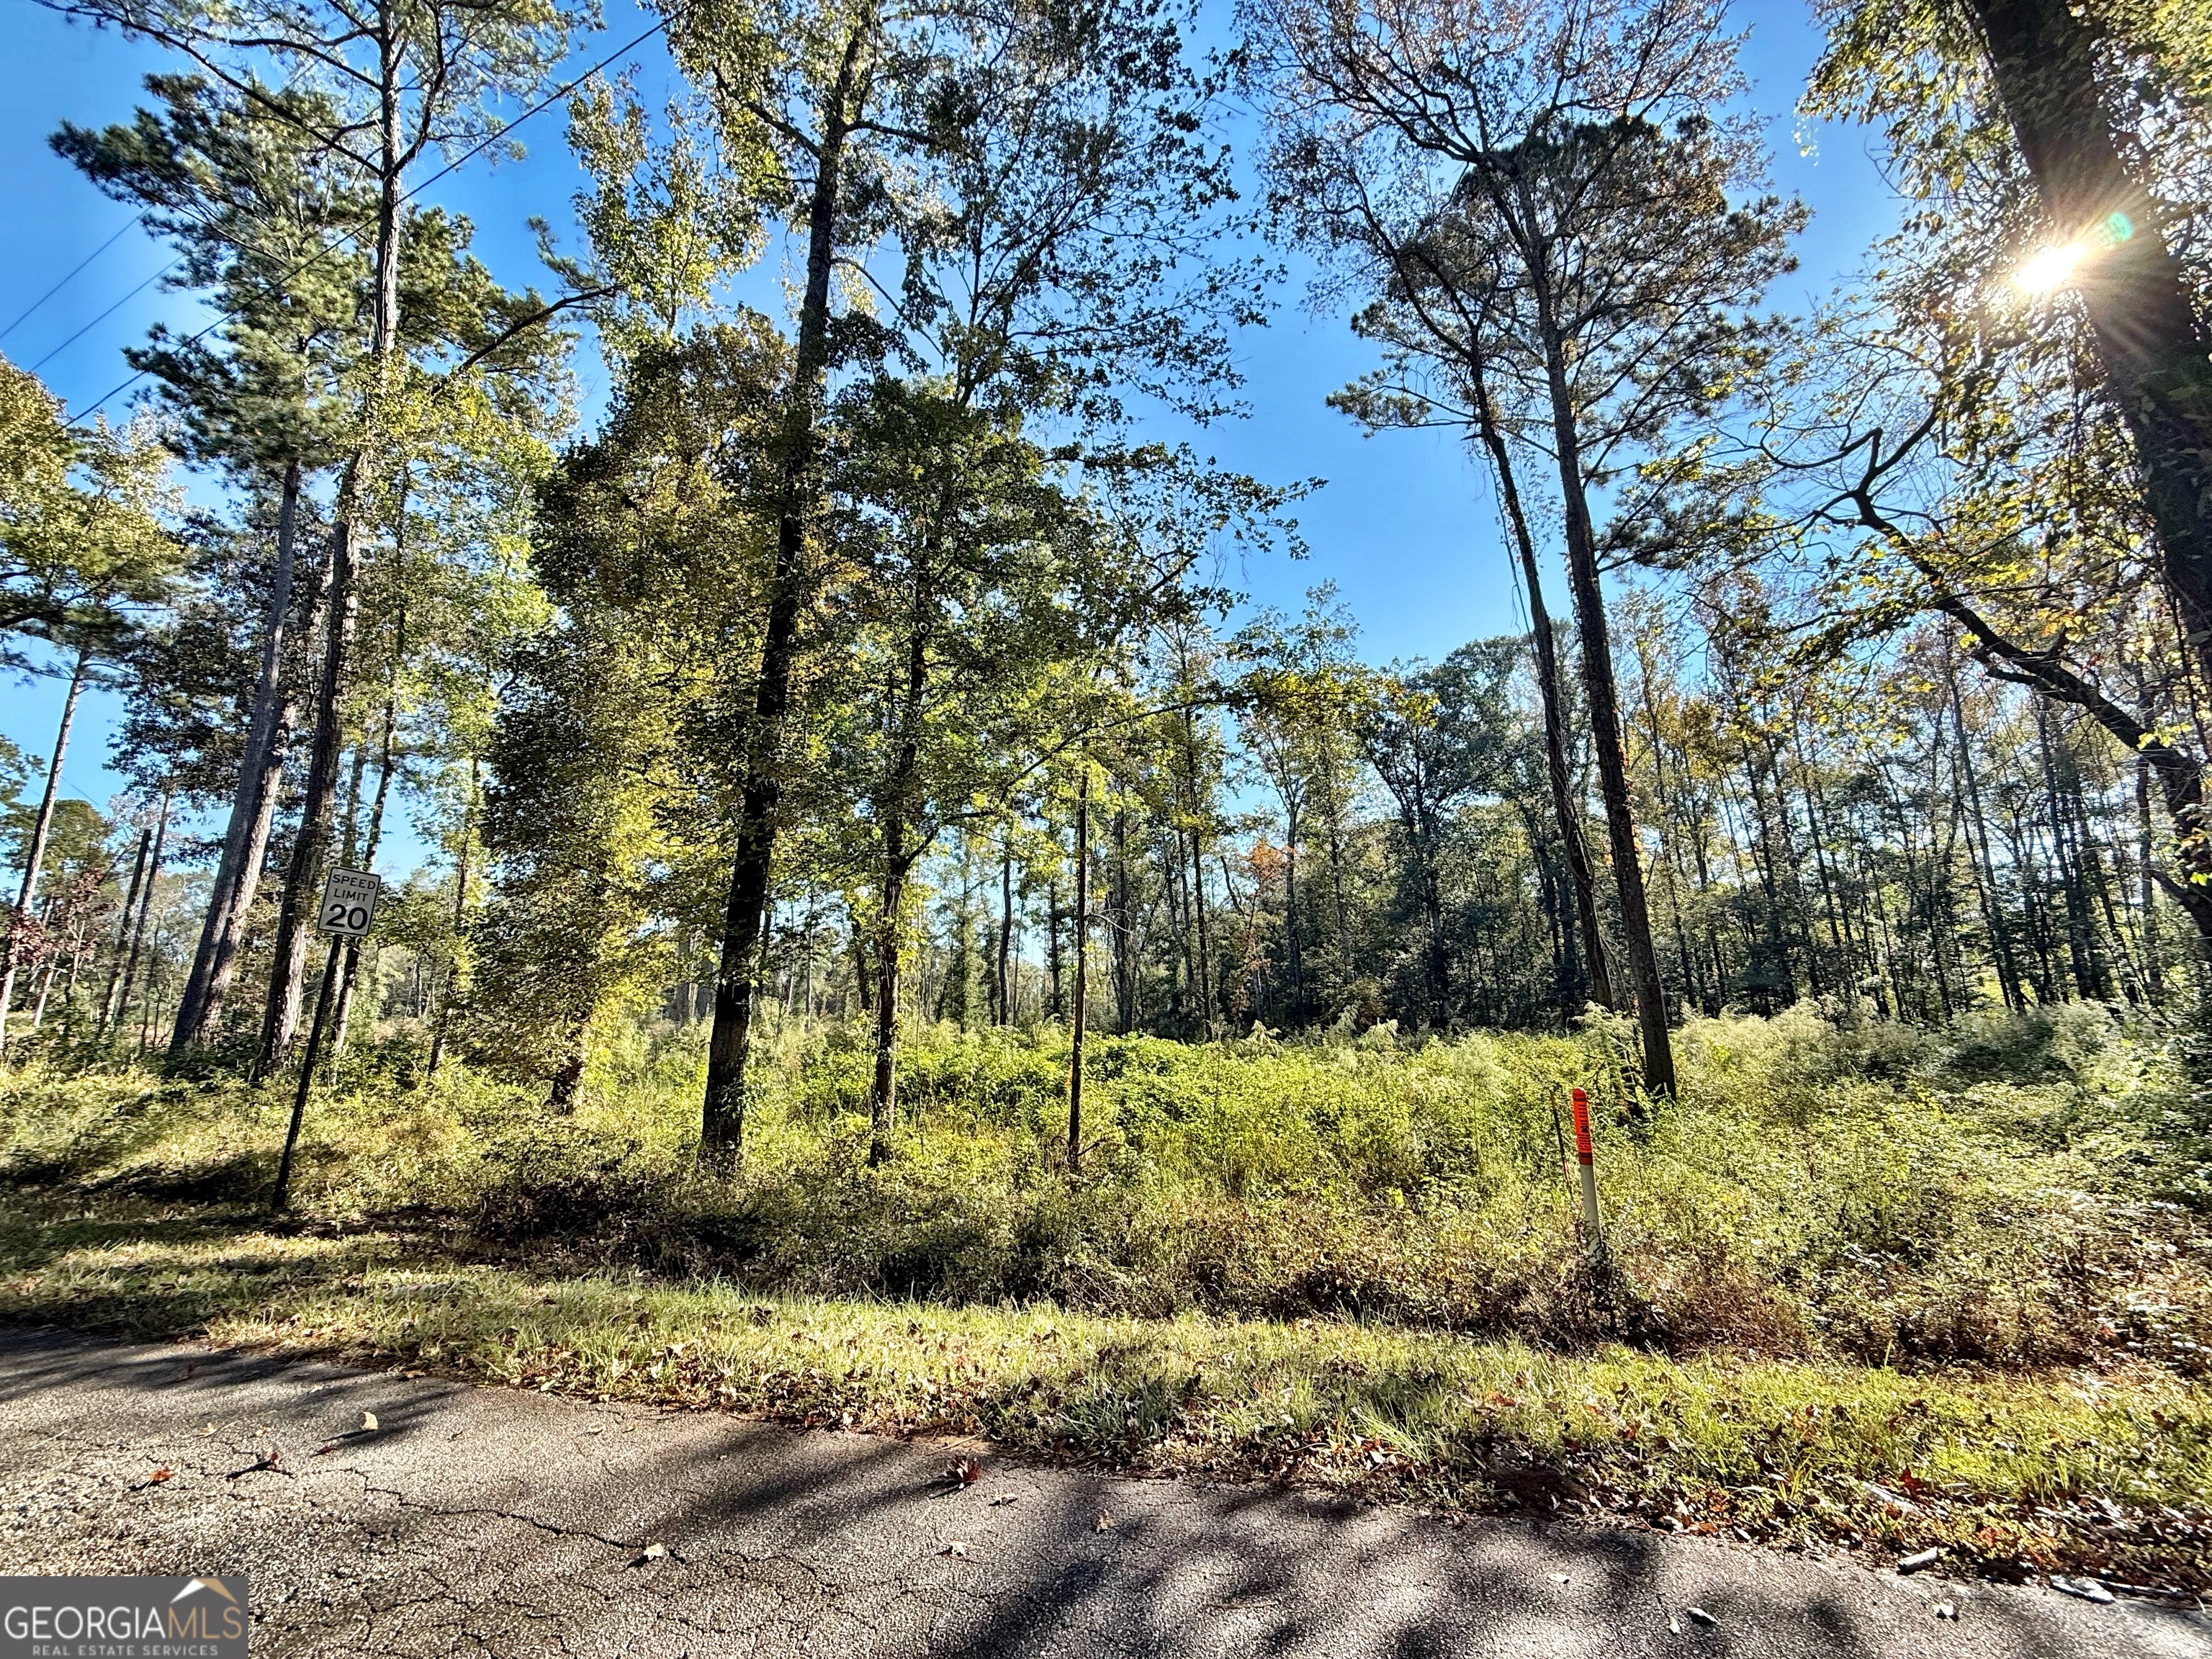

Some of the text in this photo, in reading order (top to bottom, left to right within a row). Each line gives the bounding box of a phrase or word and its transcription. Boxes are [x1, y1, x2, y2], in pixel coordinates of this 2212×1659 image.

[332, 874, 376, 889] SPEED
[333, 888, 368, 902] LIMIT
[325, 904, 368, 930] 20
